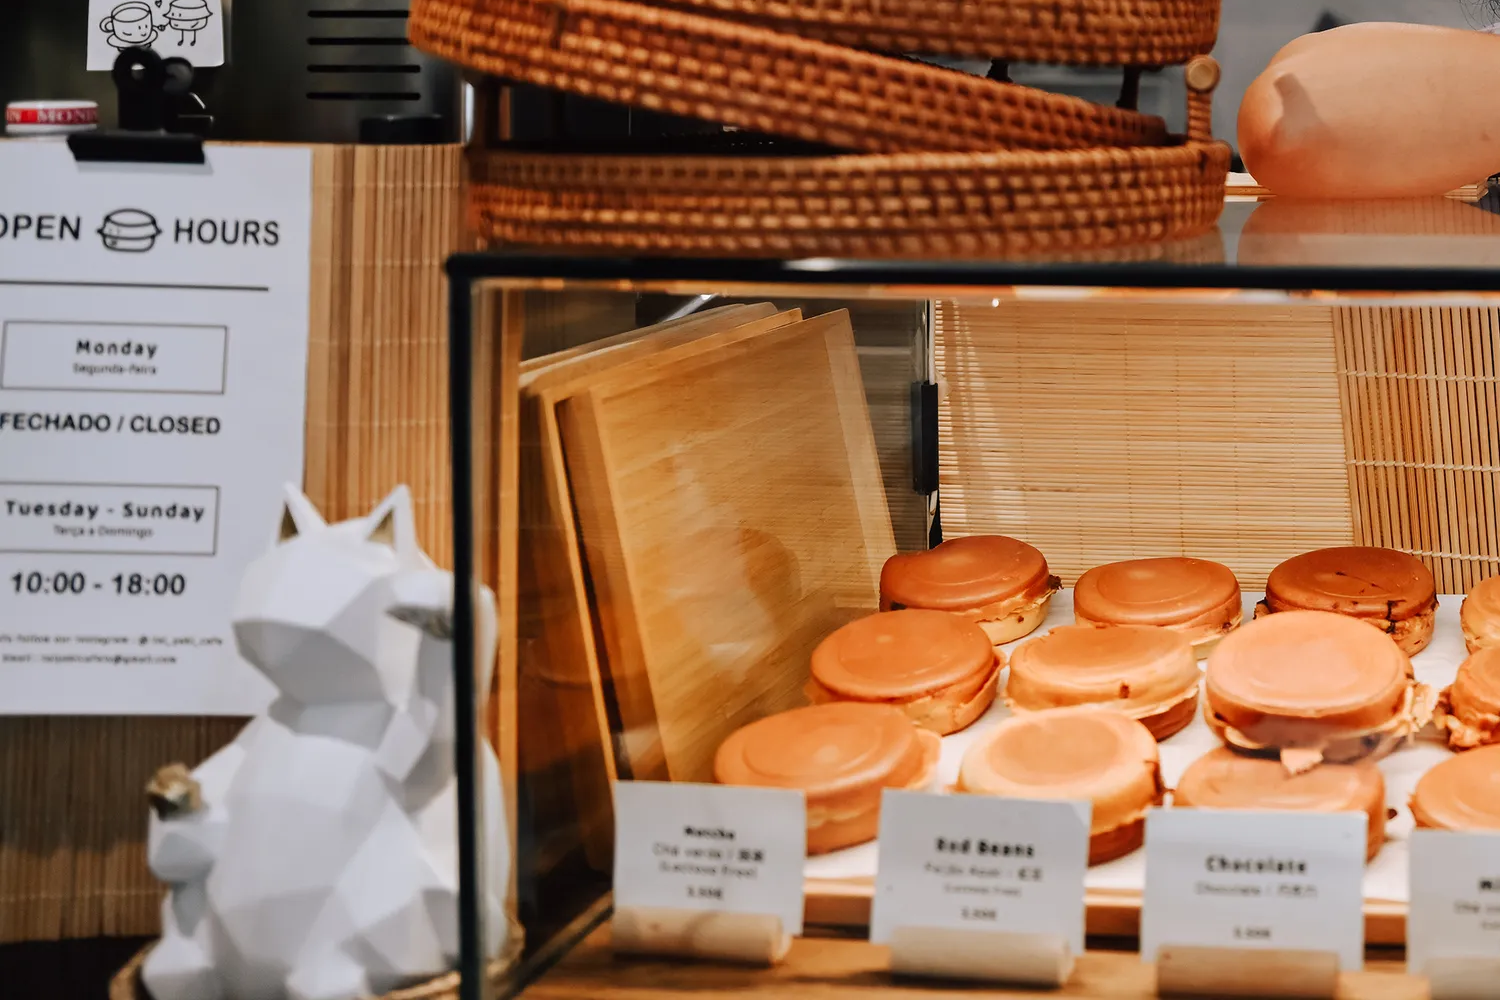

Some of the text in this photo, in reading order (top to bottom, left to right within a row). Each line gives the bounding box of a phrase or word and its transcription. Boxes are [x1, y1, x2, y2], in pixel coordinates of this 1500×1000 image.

[173, 219, 280, 245] HOURS
[76, 339, 158, 358] Monday
[0, 413, 111, 431] FECHADO
[130, 415, 220, 434] CLOSED
[6, 501, 99, 520] Tuesday
[123, 502, 205, 522] Sunday
[97, 526, 153, 538] Domingo
[11, 572, 86, 593] 10:00
[111, 573, 187, 595] 18:00
[935, 837, 1034, 858] Red Beans
[1205, 856, 1307, 874] Chocolate
